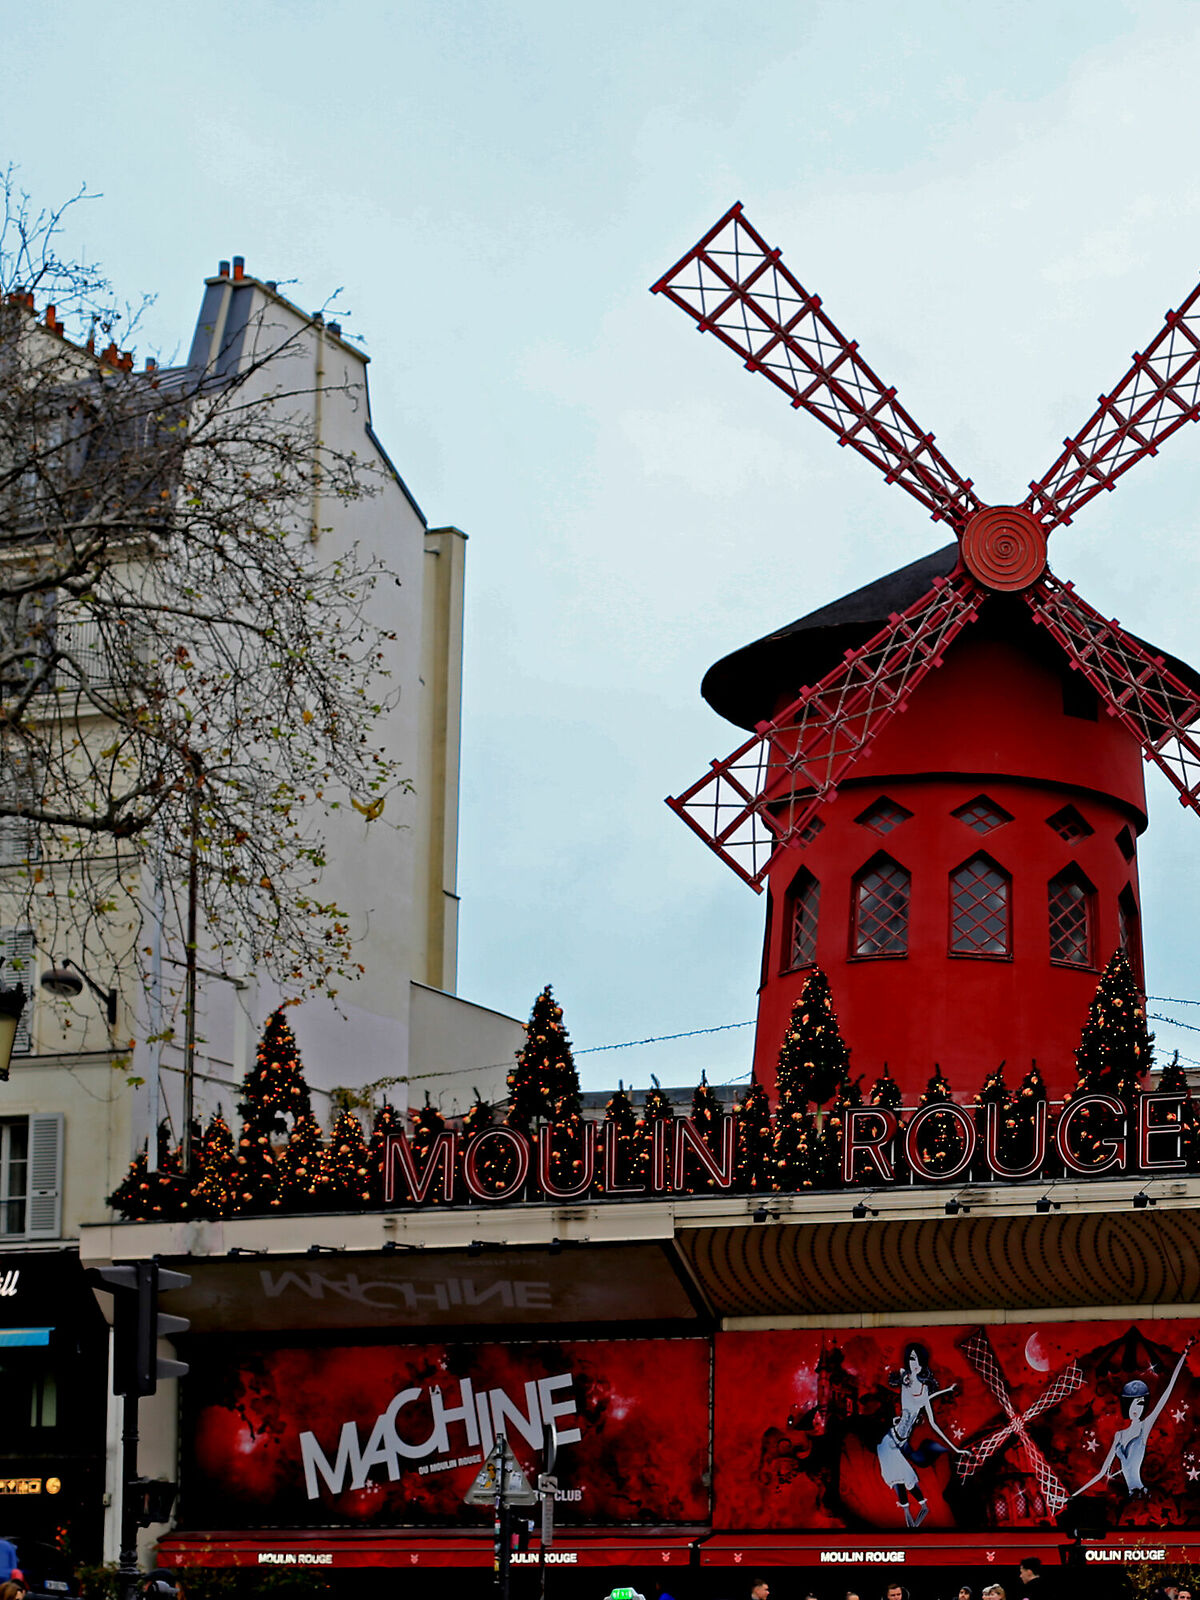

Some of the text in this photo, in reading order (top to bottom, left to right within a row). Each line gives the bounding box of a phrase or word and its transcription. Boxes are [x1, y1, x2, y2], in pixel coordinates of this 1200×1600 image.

[384, 1091, 1191, 1203] MOULIN ROUGE
[299, 1373, 582, 1500] MACHINE
[554, 1490, 582, 1501] CLUB
[258, 1553, 333, 1565] MOULIN ROUGE
[509, 1553, 540, 1564] ULIN
[820, 1551, 905, 1562] MOULIN ROUGE
[1084, 1549, 1166, 1561] OULIN ROUGE
